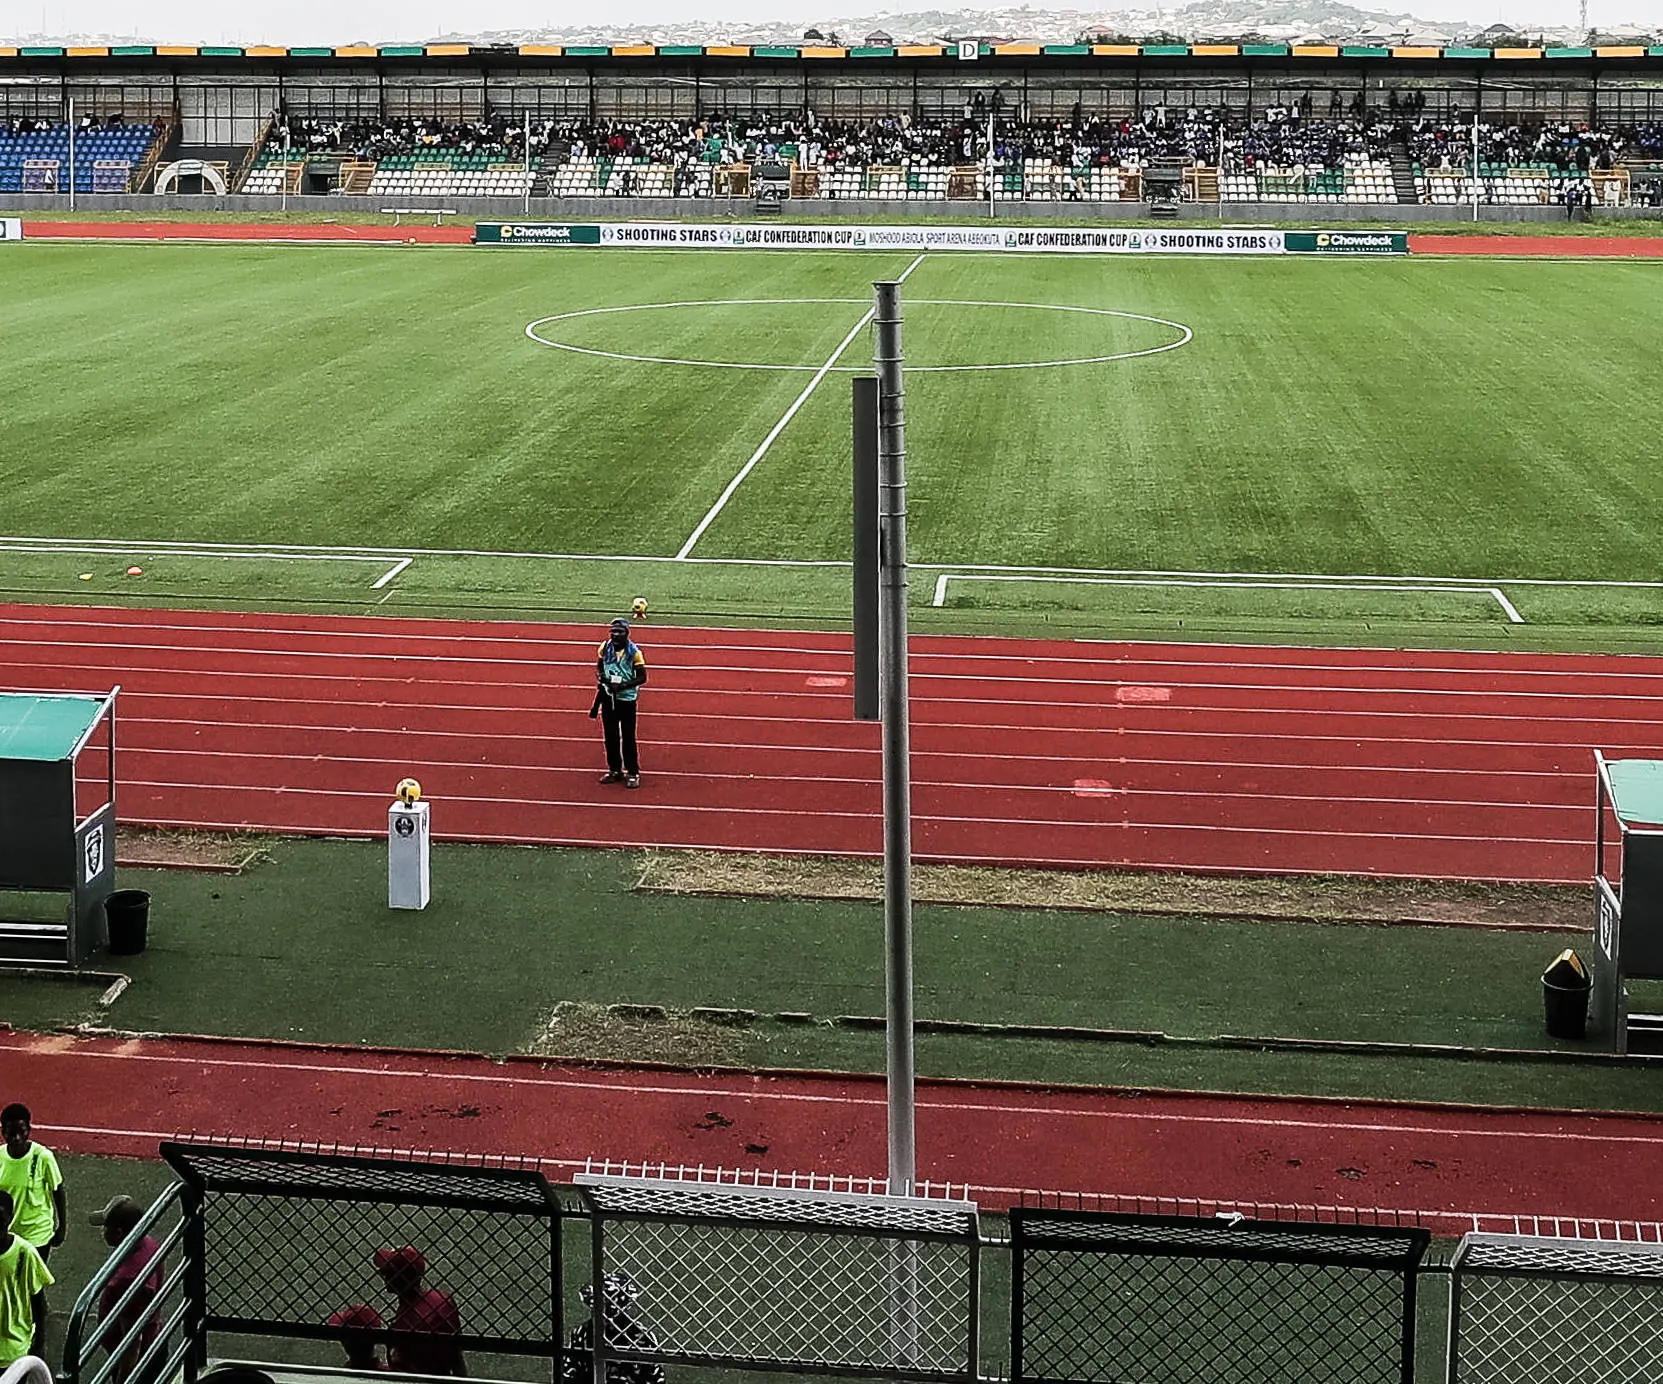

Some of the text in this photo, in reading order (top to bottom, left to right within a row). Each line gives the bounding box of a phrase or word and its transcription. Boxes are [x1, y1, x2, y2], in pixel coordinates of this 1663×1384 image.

[962, 43, 975, 57] D
[513, 226, 570, 238] Chowdeck
[616, 228, 718, 242] SHOOTING STARS
[745, 229, 852, 244] CAF CONFEDERATION CUP
[1018, 232, 1127, 246] CAF CONFEDERATION CUP
[1160, 234, 1266, 248] SHOOTING STARS
[1330, 235, 1392, 246] Chowdeck
